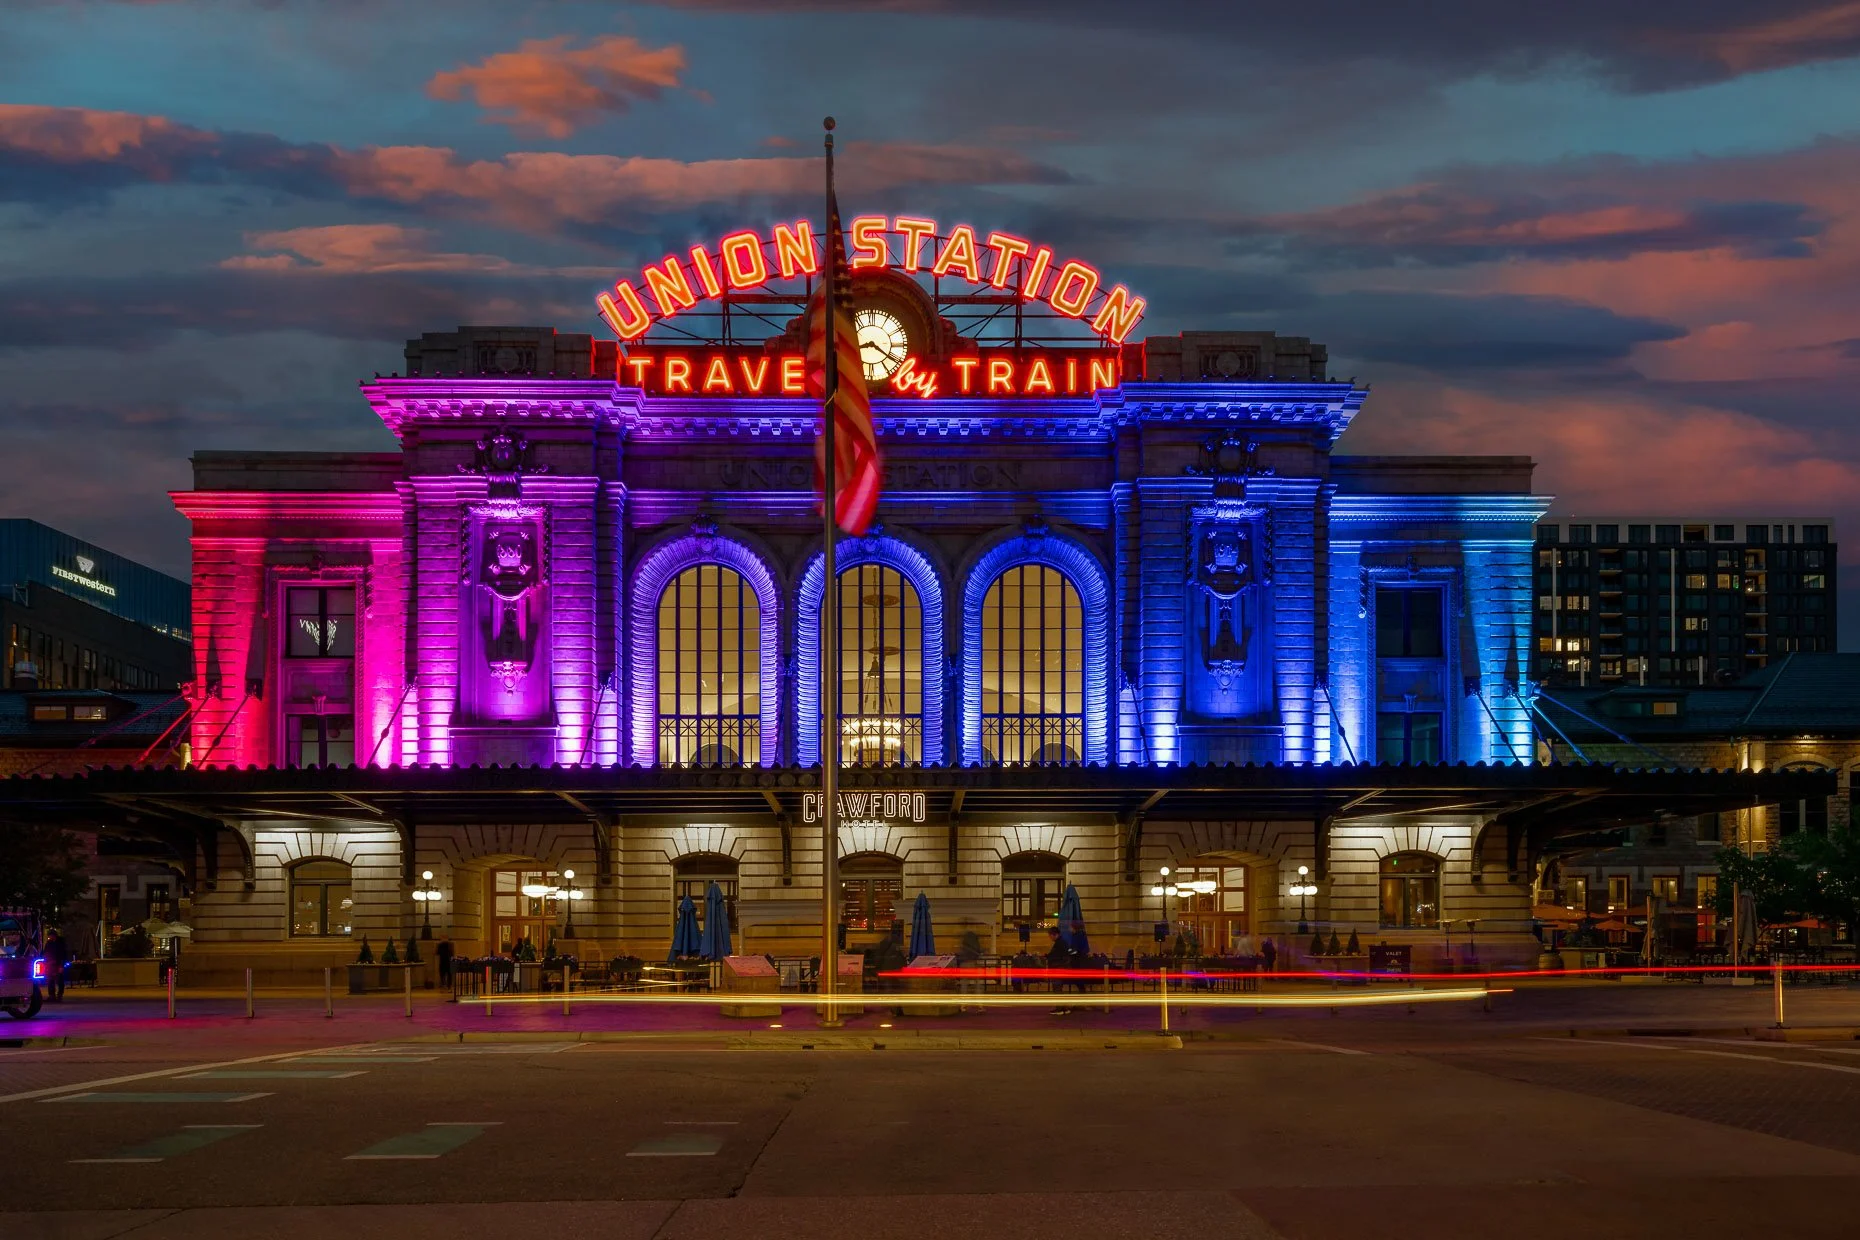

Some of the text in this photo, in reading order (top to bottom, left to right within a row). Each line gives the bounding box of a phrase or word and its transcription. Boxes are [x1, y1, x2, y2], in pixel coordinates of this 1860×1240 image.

[598, 216, 1147, 345] UNION STATION
[626, 356, 1117, 398] TRAVE by TRAIN
[720, 463, 810, 488] UNIO
